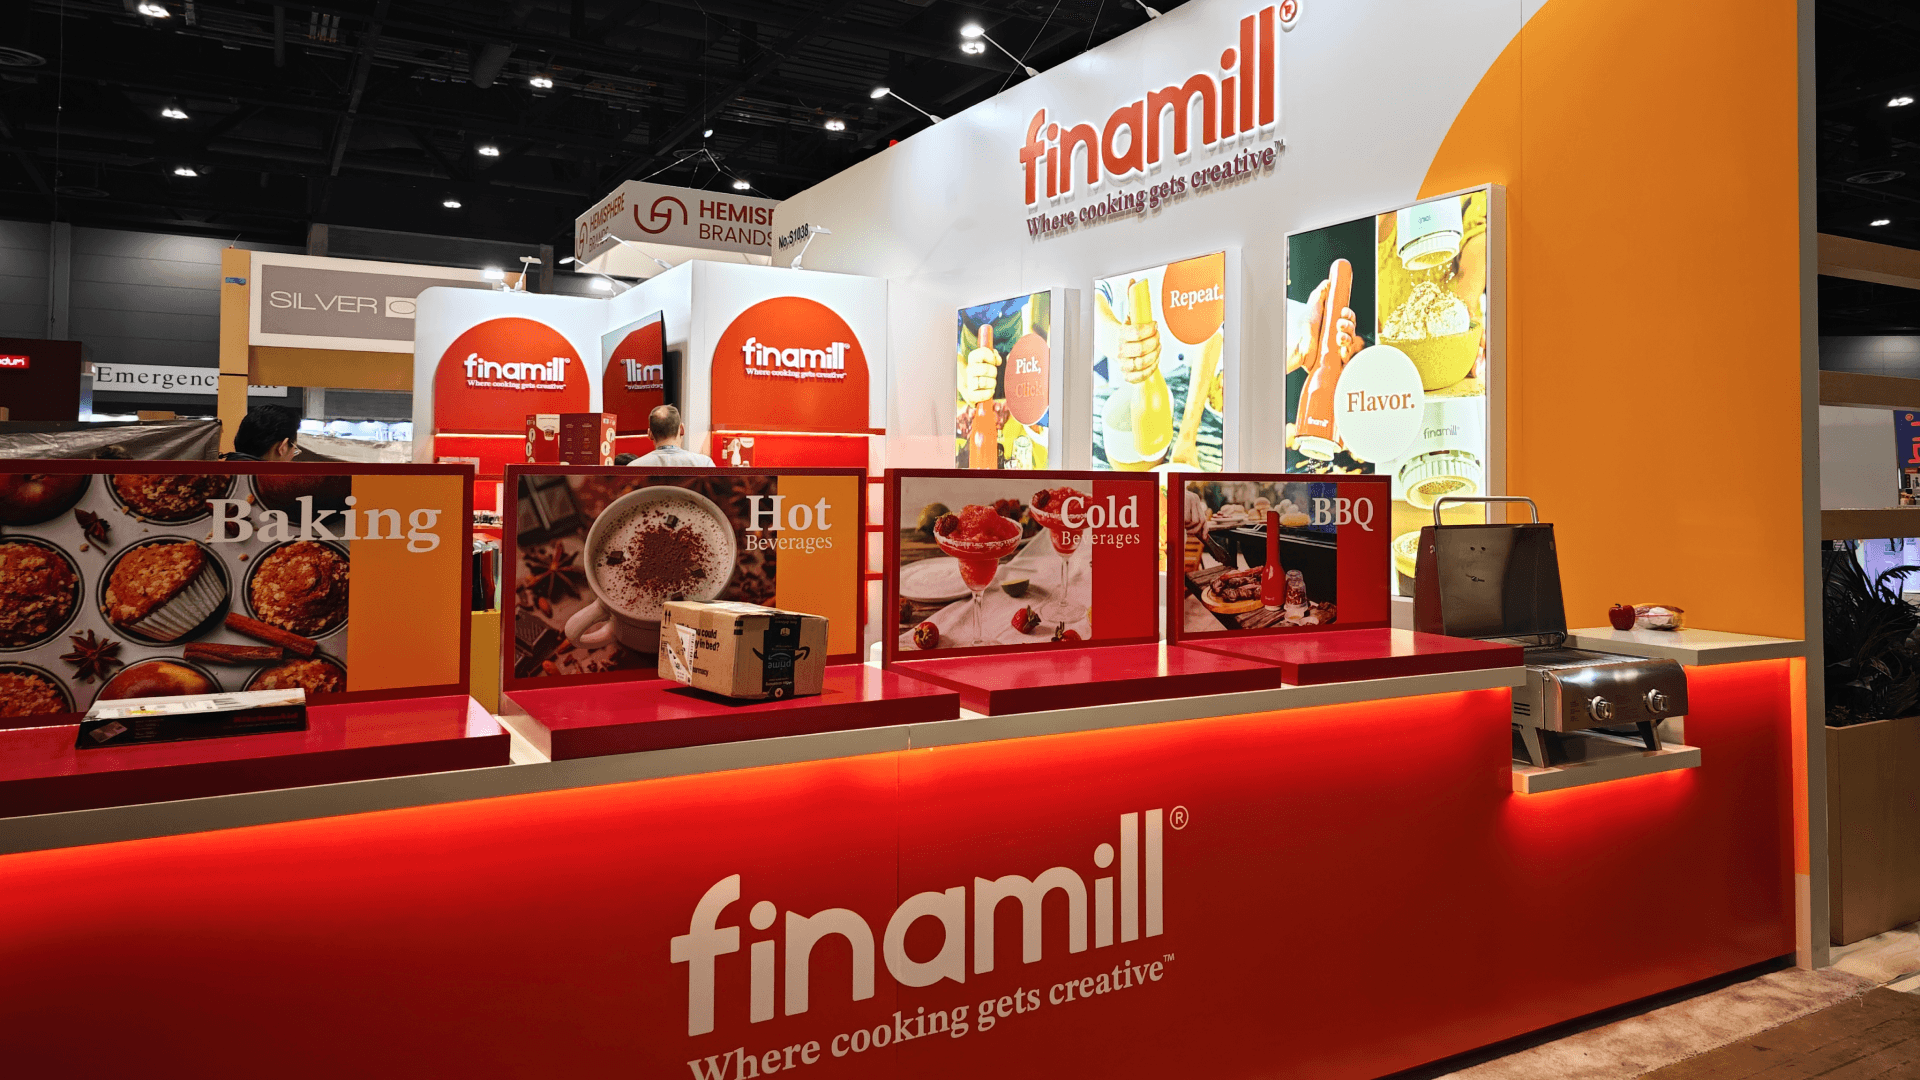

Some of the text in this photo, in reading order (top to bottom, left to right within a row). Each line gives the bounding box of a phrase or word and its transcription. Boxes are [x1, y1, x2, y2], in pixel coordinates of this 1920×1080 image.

[1026, 211, 1074, 237] Where
[1079, 190, 1145, 222] cooking
[1150, 175, 1186, 209] gets
[269, 291, 378, 314] SILVER
[1169, 283, 1224, 310] Repeat.
[1015, 356, 1041, 375] Pick,
[96, 366, 219, 391] Emergenc
[1346, 390, 1415, 413] Flavor.
[205, 495, 442, 553] Baking
[745, 495, 832, 531] Hot
[1061, 495, 1139, 529] Cold
[1312, 497, 1374, 532] BBQ
[745, 534, 833, 554] Beverages
[1061, 531, 1140, 549] Beverages
[701, 629, 717, 639] could
[706, 641, 720, 652] bed?
[767, 659, 792, 670] prime
[687, 1037, 821, 1080] Where
[830, 1004, 970, 1059] cooking
[978, 982, 1041, 1031] gets
